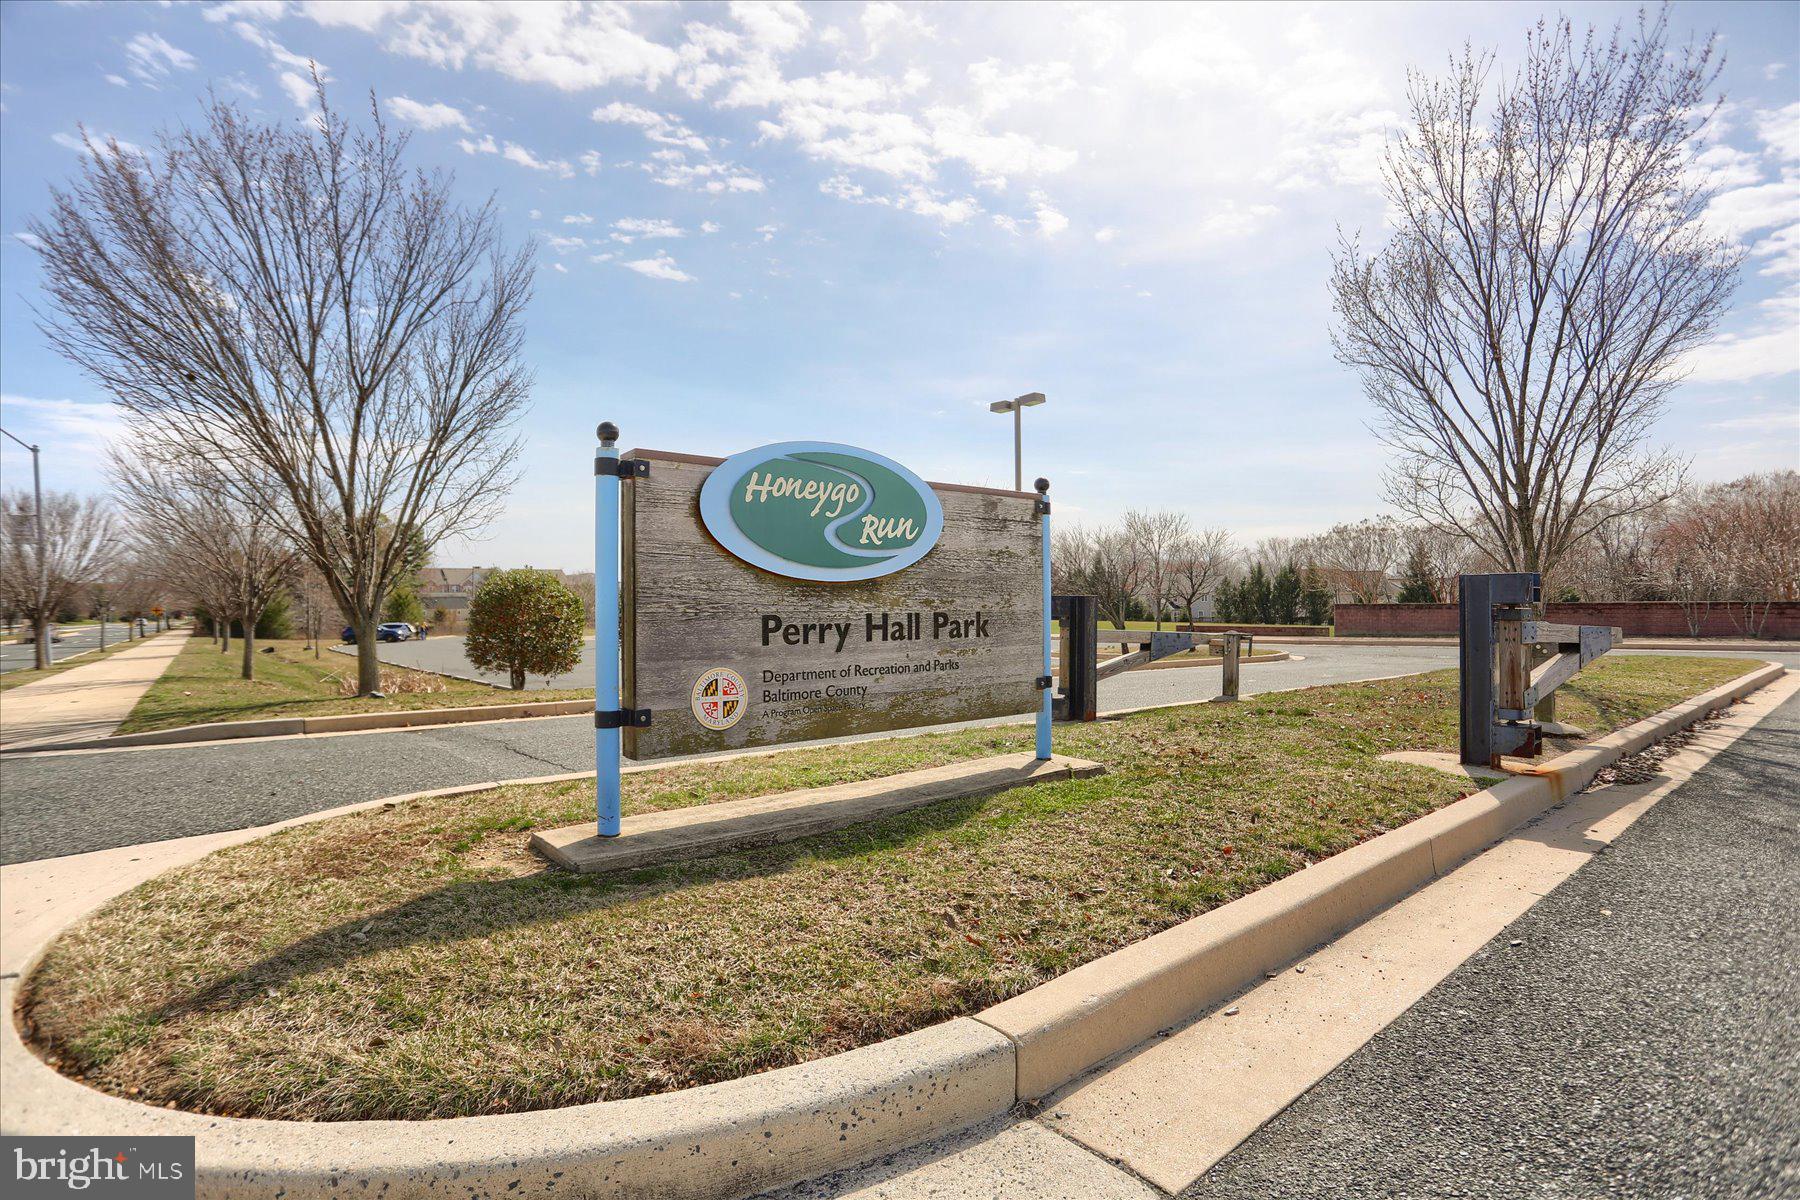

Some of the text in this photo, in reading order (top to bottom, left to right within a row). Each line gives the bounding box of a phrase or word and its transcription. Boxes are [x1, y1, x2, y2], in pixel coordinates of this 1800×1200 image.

[745, 472, 860, 518] Honeygo
[859, 514, 919, 545] Run
[761, 611, 990, 652] Perry Hall Park
[763, 659, 960, 685] Department of Recreation and Parks
[763, 685, 868, 703] Baltimore County
[761, 710, 769, 719] A
[771, 708, 801, 719] Program
[803, 706, 822, 715] Open
